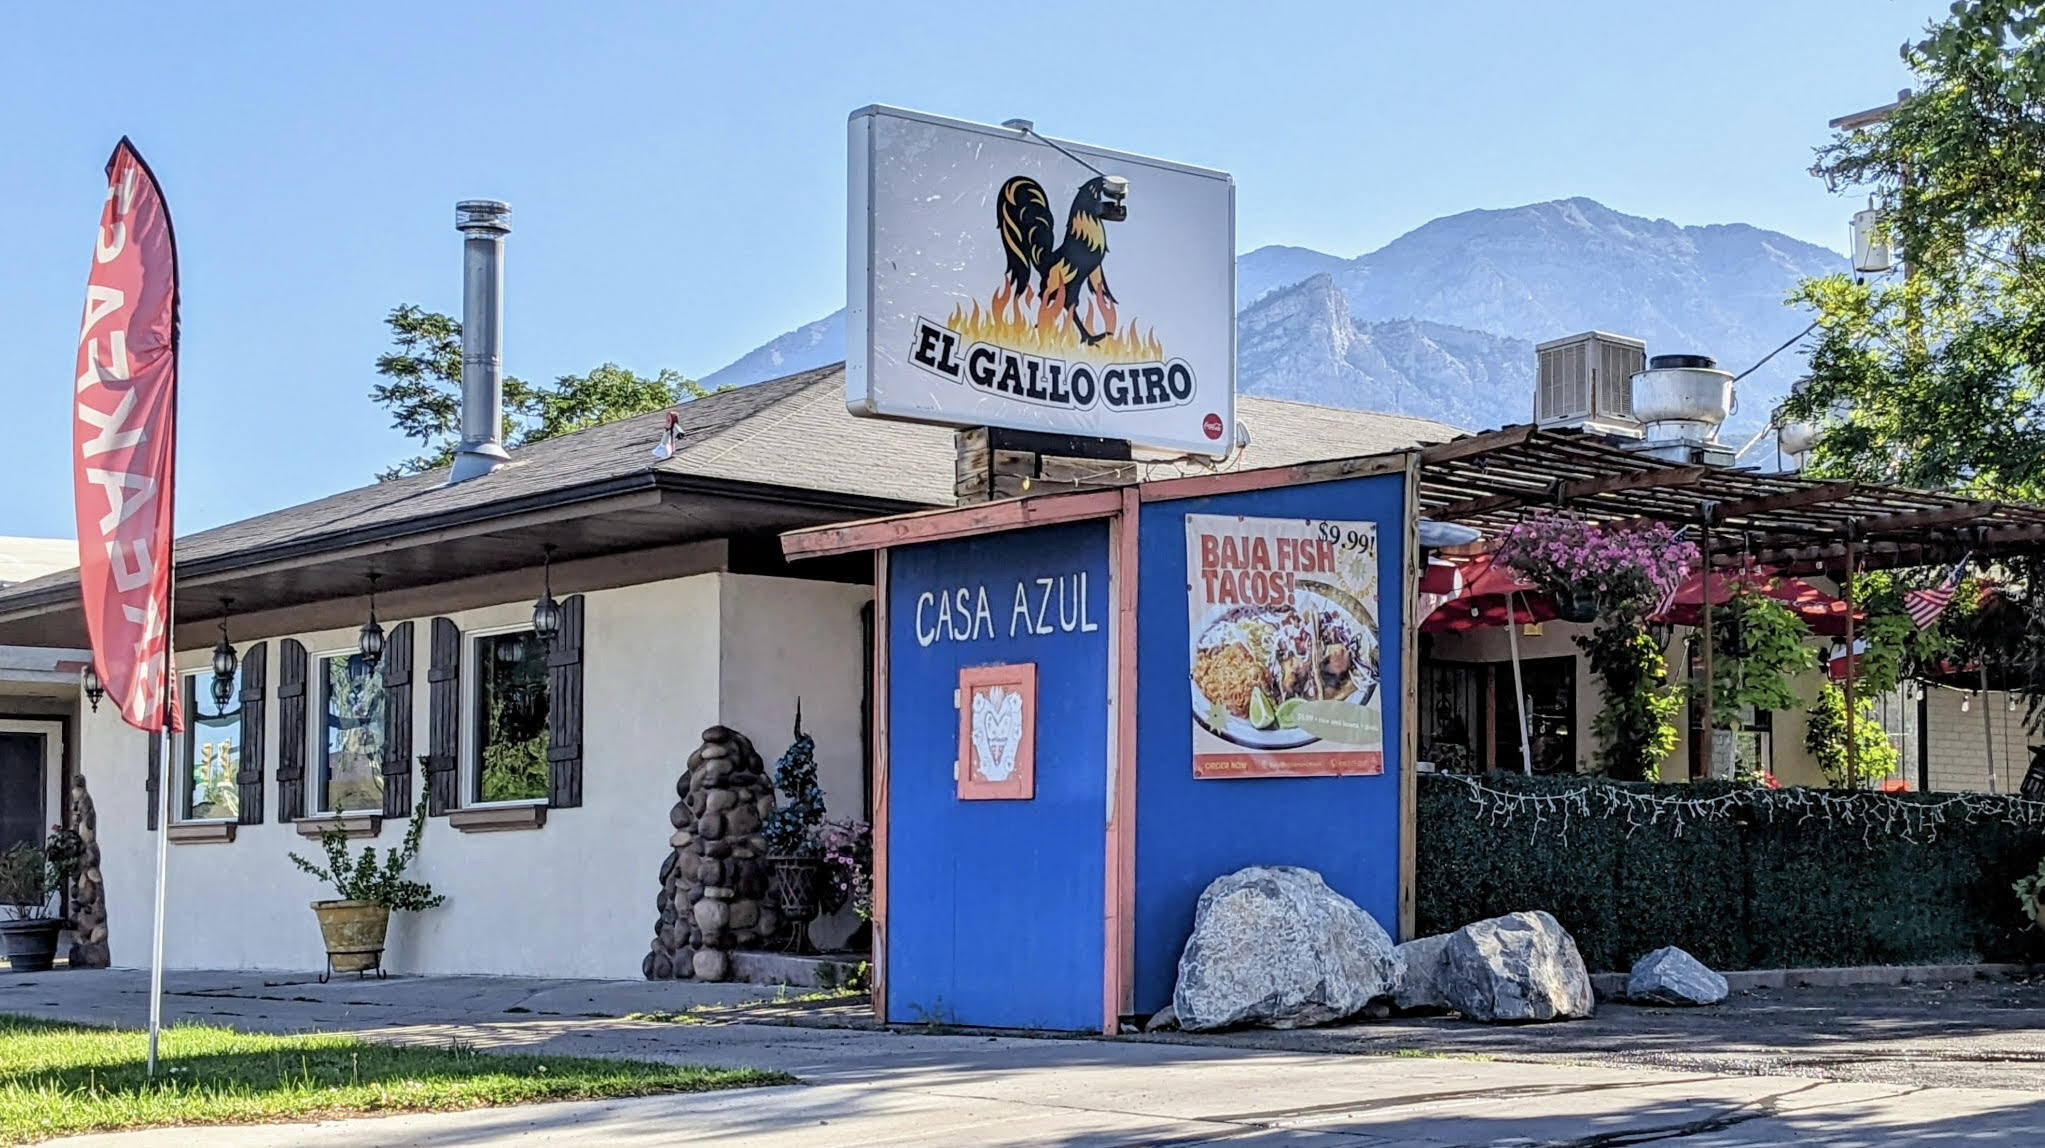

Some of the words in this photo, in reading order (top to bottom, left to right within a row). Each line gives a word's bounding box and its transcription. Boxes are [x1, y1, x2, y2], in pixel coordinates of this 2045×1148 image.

[914, 324, 960, 377] EL
[968, 348, 1095, 405] GALLO
[1103, 363, 1192, 407] GIRO
[1200, 534, 1272, 571] BAJA
[1276, 537, 1336, 573] FISH
[1318, 521, 1375, 558] $9.99!
[1201, 569, 1296, 606] TACOS!
[915, 585, 995, 647] CASA
[1009, 571, 1098, 638] AZUL
